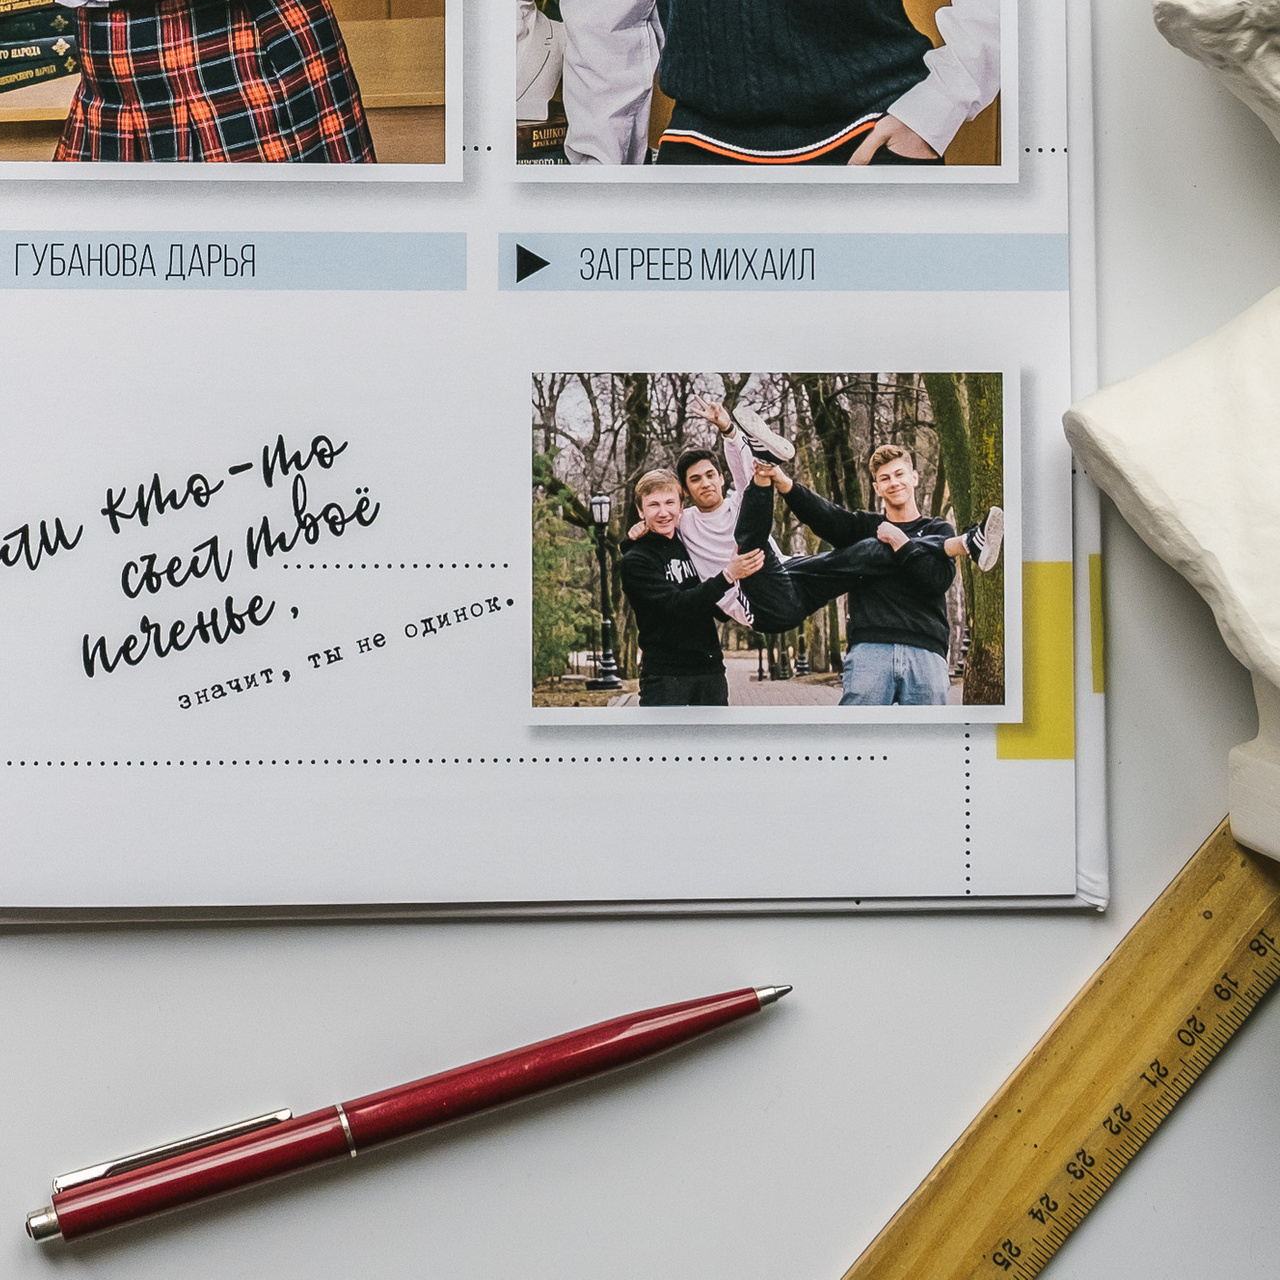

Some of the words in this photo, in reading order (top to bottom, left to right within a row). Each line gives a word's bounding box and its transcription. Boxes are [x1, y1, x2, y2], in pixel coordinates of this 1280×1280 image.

[15, 243, 156, 277] ГУБАНОВА
[165, 243, 256, 281] ДАРЬЯ
[580, 247, 693, 281] ЗАГРЕЕВ
[701, 247, 815, 281] МИХАИЛ
[101, 434, 348, 534] кто-то
[121, 535, 233, 599] съел
[246, 473, 380, 570] твоё
[178, 665, 291, 711] значит,
[307, 646, 344, 671] ты
[358, 629, 388, 656] не
[404, 594, 516, 640] одинок.
[1250, 928, 1275, 957] 18
[1213, 972, 1239, 1001] 19
[1177, 1014, 1206, 1047] 20
[1139, 1058, 1169, 1088] 21
[1102, 1103, 1133, 1136] 22
[1066, 1148, 1096, 1180] 23
[1028, 1192, 1059, 1225] 24
[992, 1238, 1022, 1271] 25
